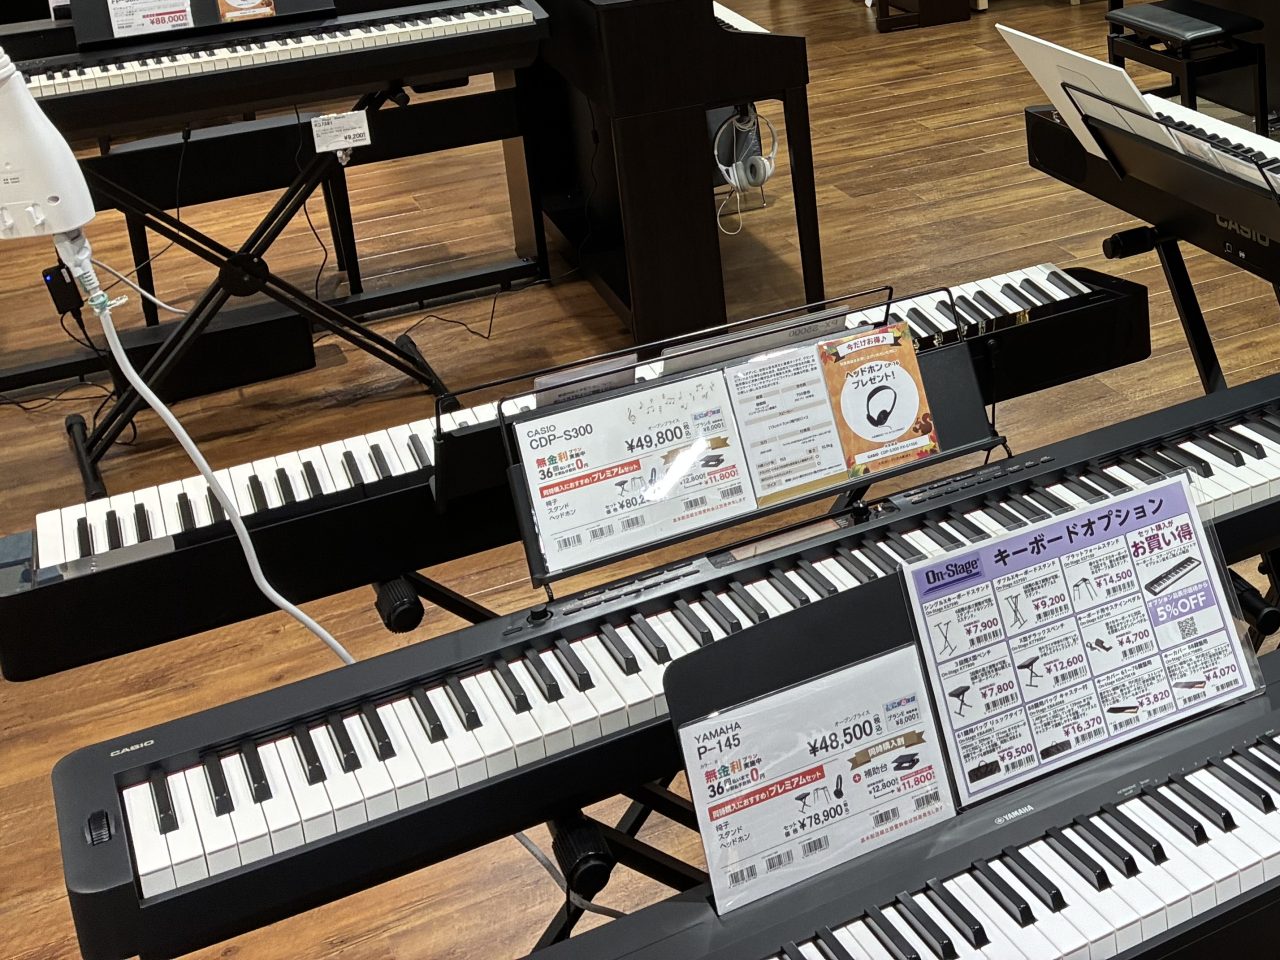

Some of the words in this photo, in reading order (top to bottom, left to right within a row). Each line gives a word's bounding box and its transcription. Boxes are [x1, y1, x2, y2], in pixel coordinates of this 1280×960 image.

[846, 363, 883, 379] ヘッドホン
[852, 370, 896, 390] プレゼント!
[526, 424, 557, 439] CASIO
[529, 423, 594, 450] CDP-S300
[625, 425, 684, 454] ¥49,800
[535, 450, 569, 469] 無金利
[547, 503, 570, 514] スタンド
[549, 508, 576, 520] ヘッドホン
[993, 497, 1164, 567] キーボードオプション
[1137, 519, 1174, 538] セット購入が
[1065, 539, 1120, 561] プラットフォームスタンド
[1131, 522, 1194, 559] お買い得
[925, 558, 979, 585] On-Stage
[1095, 569, 1133, 589] ¥14,500
[1033, 593, 1066, 611] ¥9,200
[1157, 592, 1208, 622] 5%OFF
[965, 617, 999, 636] ¥7,900
[1117, 629, 1150, 647] ¥4,700
[1164, 645, 1187, 659] キーカバー
[1045, 654, 1084, 675] ¥12,600
[1205, 663, 1238, 682] ¥4,070
[1096, 670, 1120, 685] キーカバー
[980, 680, 1015, 699] ¥7,800
[1138, 689, 1170, 708] ¥3,820
[989, 709, 1024, 726] リュックタイプ
[1063, 715, 1102, 737] ¥16,370
[694, 721, 742, 745] YAMAHA
[808, 719, 873, 757] ¥48,500
[110, 739, 155, 757] CASIO
[697, 733, 741, 760] P-145
[999, 742, 1033, 763] ¥9,500
[704, 758, 742, 784] 無金利
[863, 763, 888, 779] 補助台
[896, 772, 932, 794] ¥11,800
[798, 804, 844, 831] ¥78,900
[1003, 804, 1035, 821] YAMAHA
[718, 826, 743, 841] スタンド
[720, 833, 751, 849] ヘッドホン
